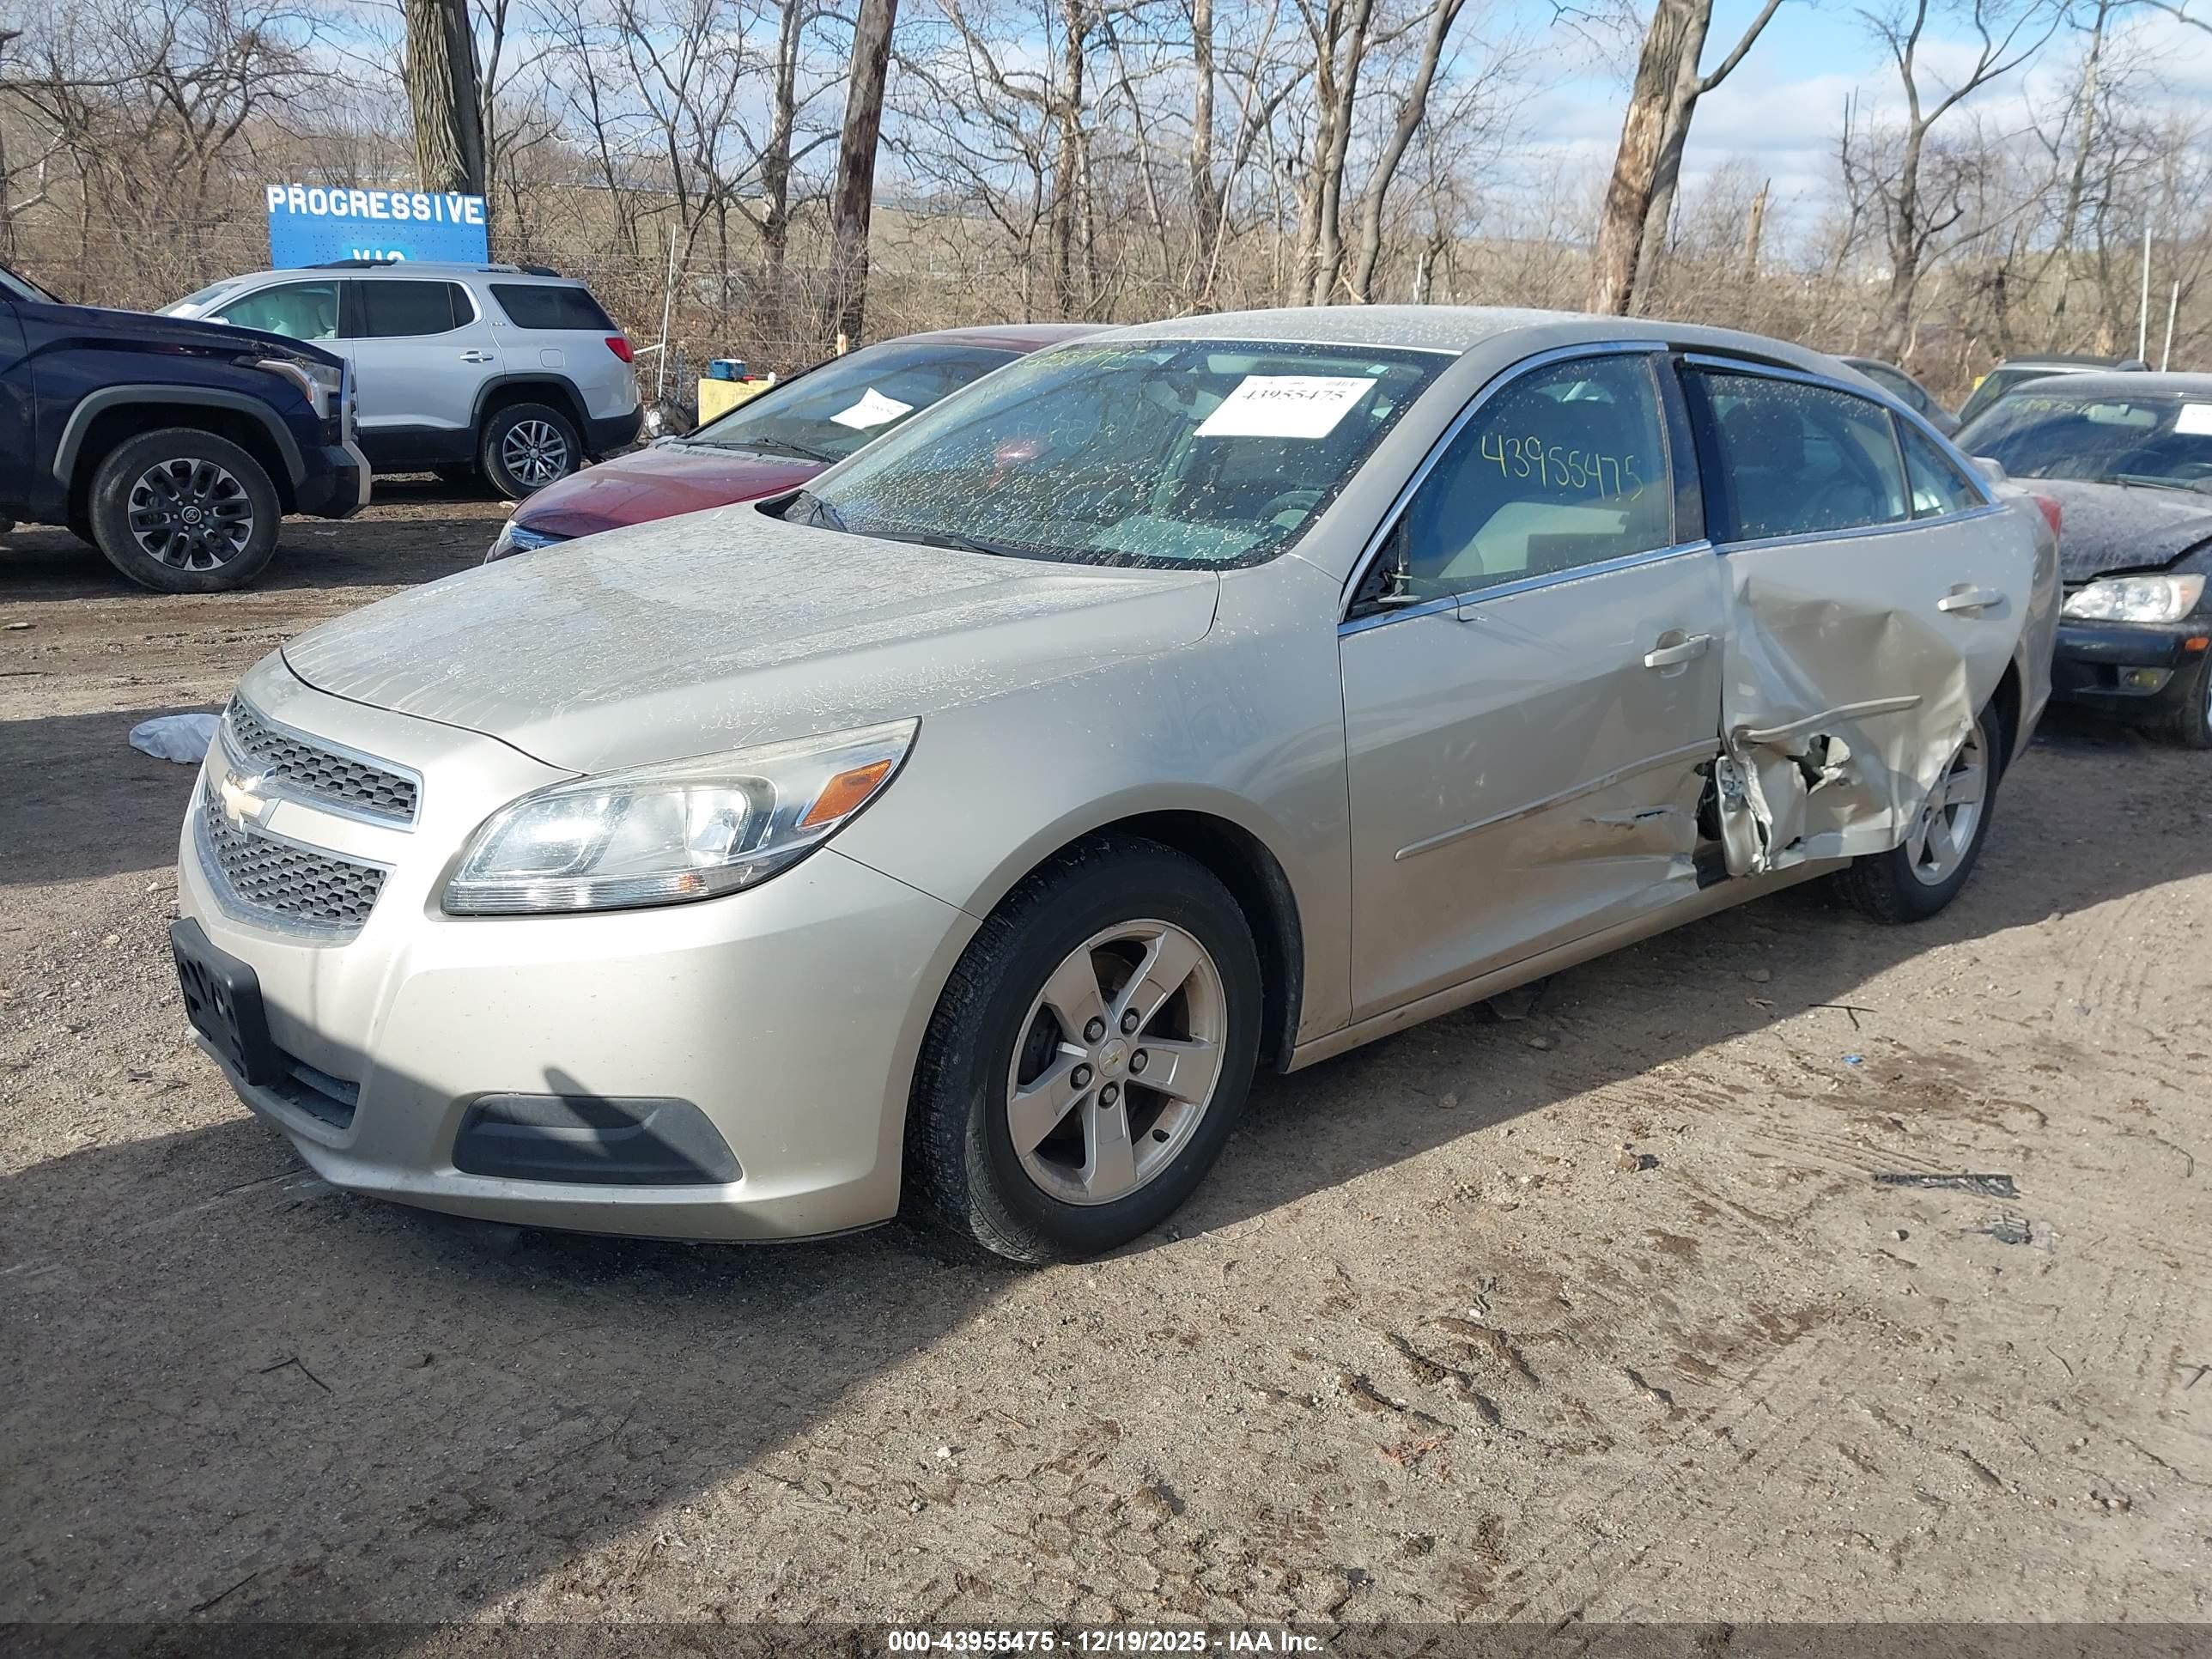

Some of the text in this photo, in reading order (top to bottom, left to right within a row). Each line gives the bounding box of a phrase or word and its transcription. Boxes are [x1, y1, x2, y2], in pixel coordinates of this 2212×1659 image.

[266, 184, 484, 225] PROGRESSIVE
[1243, 389, 1347, 401] 43955475
[1480, 434, 1644, 501] 43955475
